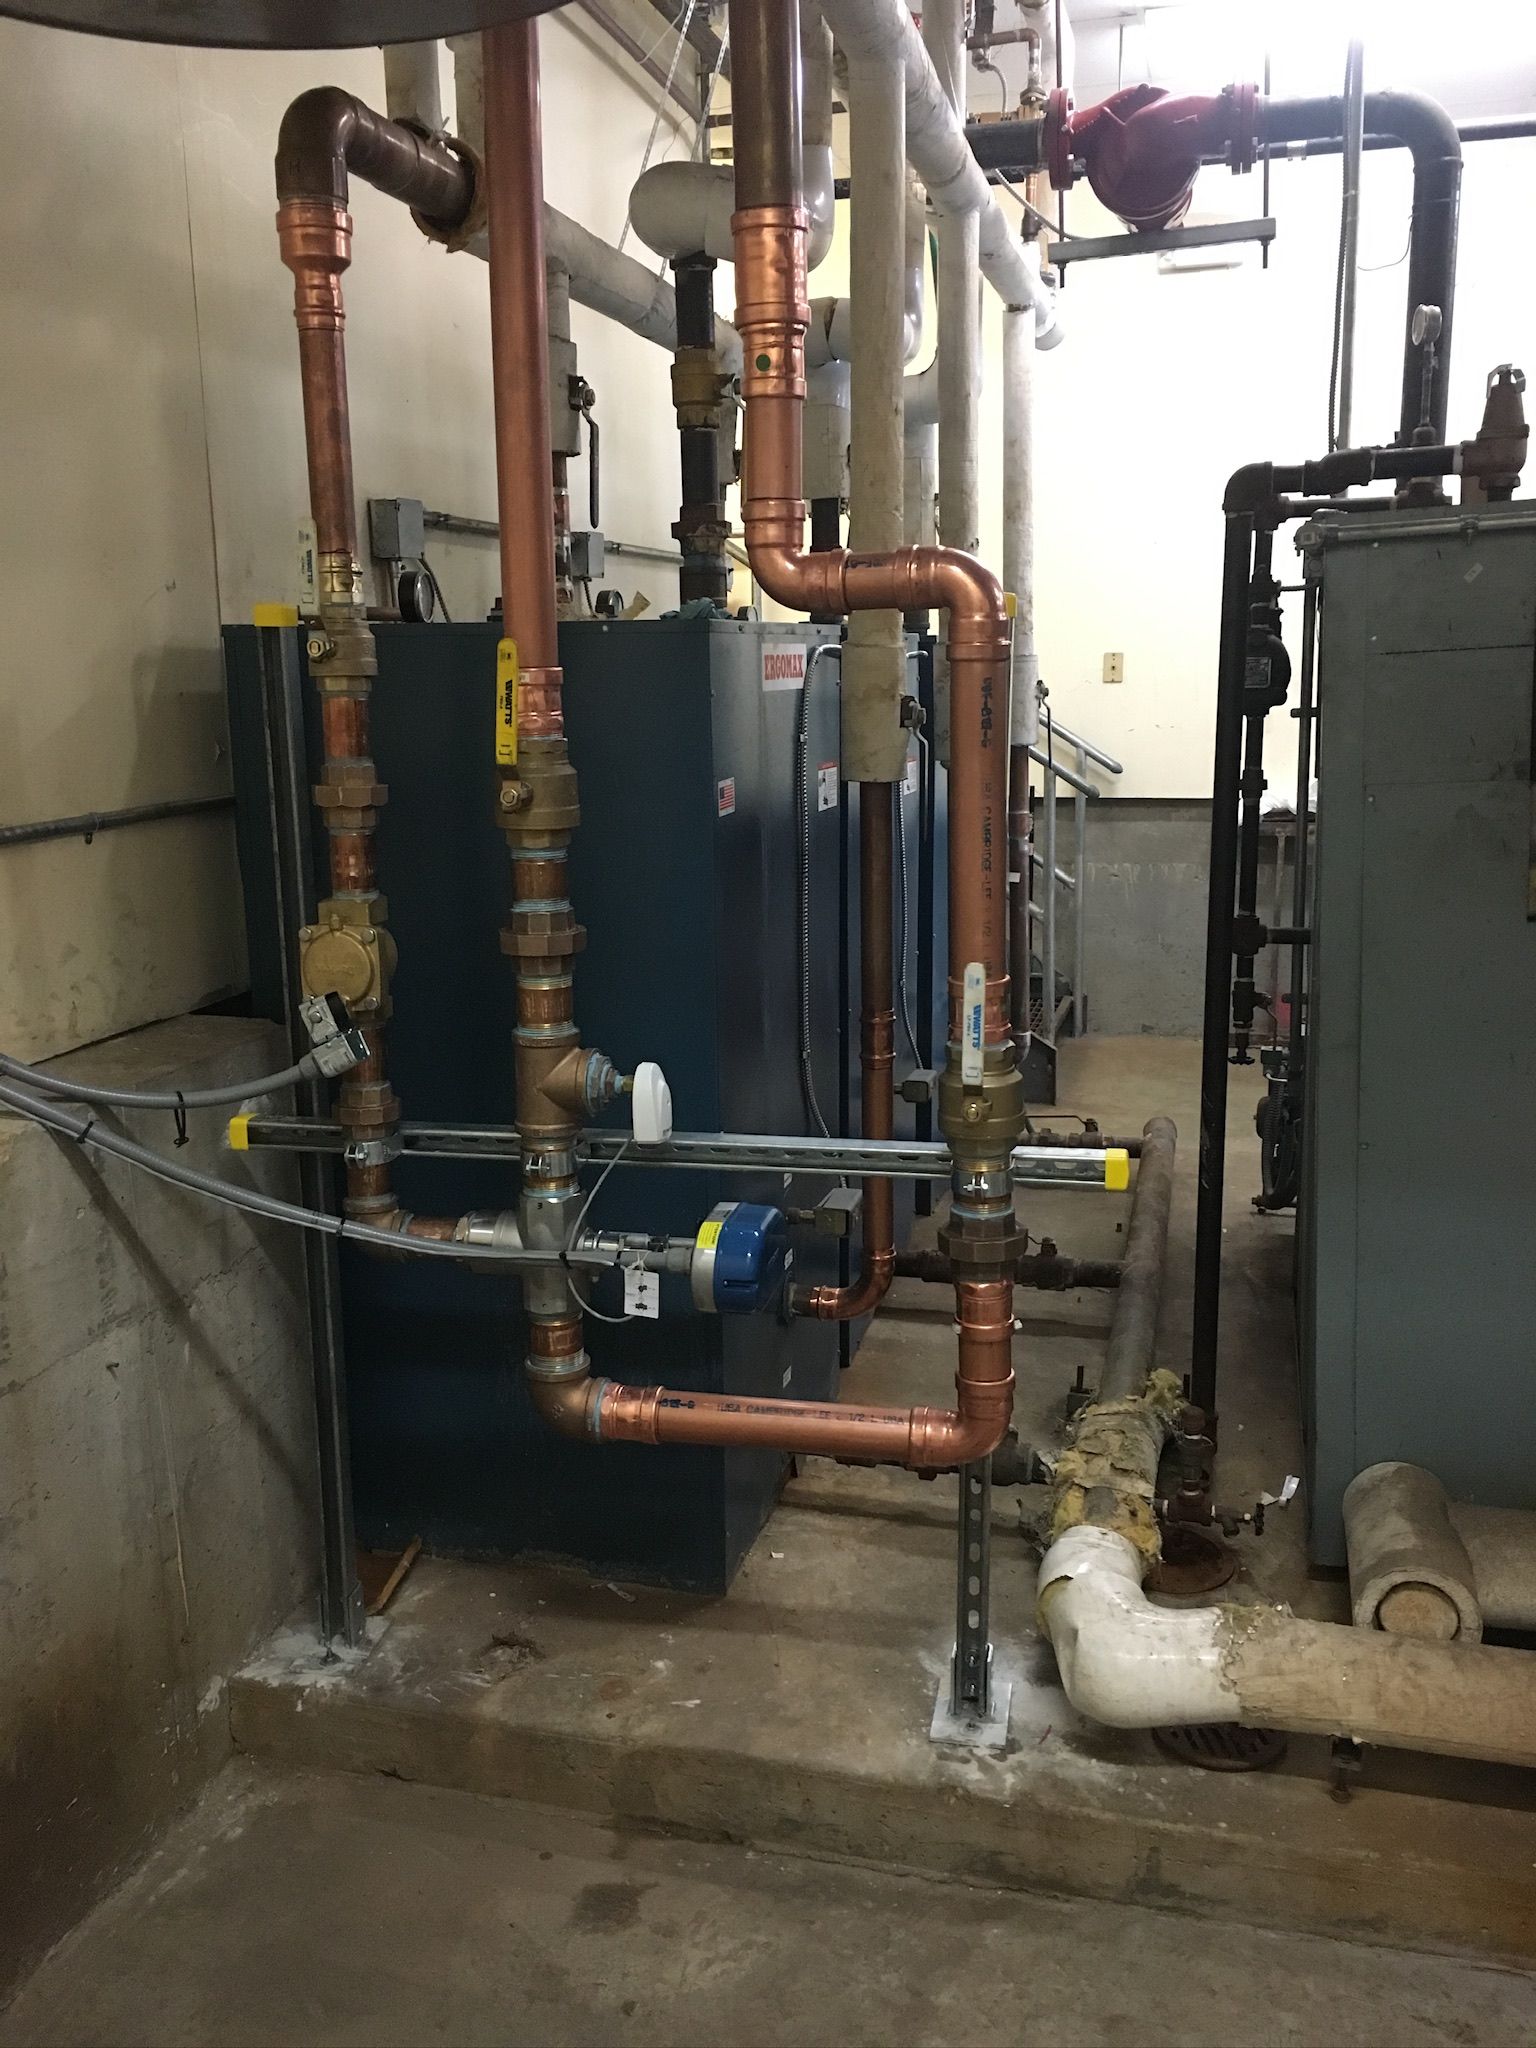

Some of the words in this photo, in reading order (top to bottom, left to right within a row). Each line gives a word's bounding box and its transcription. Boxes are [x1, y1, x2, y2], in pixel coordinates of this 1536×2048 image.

[763, 654, 804, 681] ERGOMAX
[505, 679, 513, 725] WATTS
[972, 1004, 982, 1048] WATTS
[848, 1412, 865, 1422] 1/2
